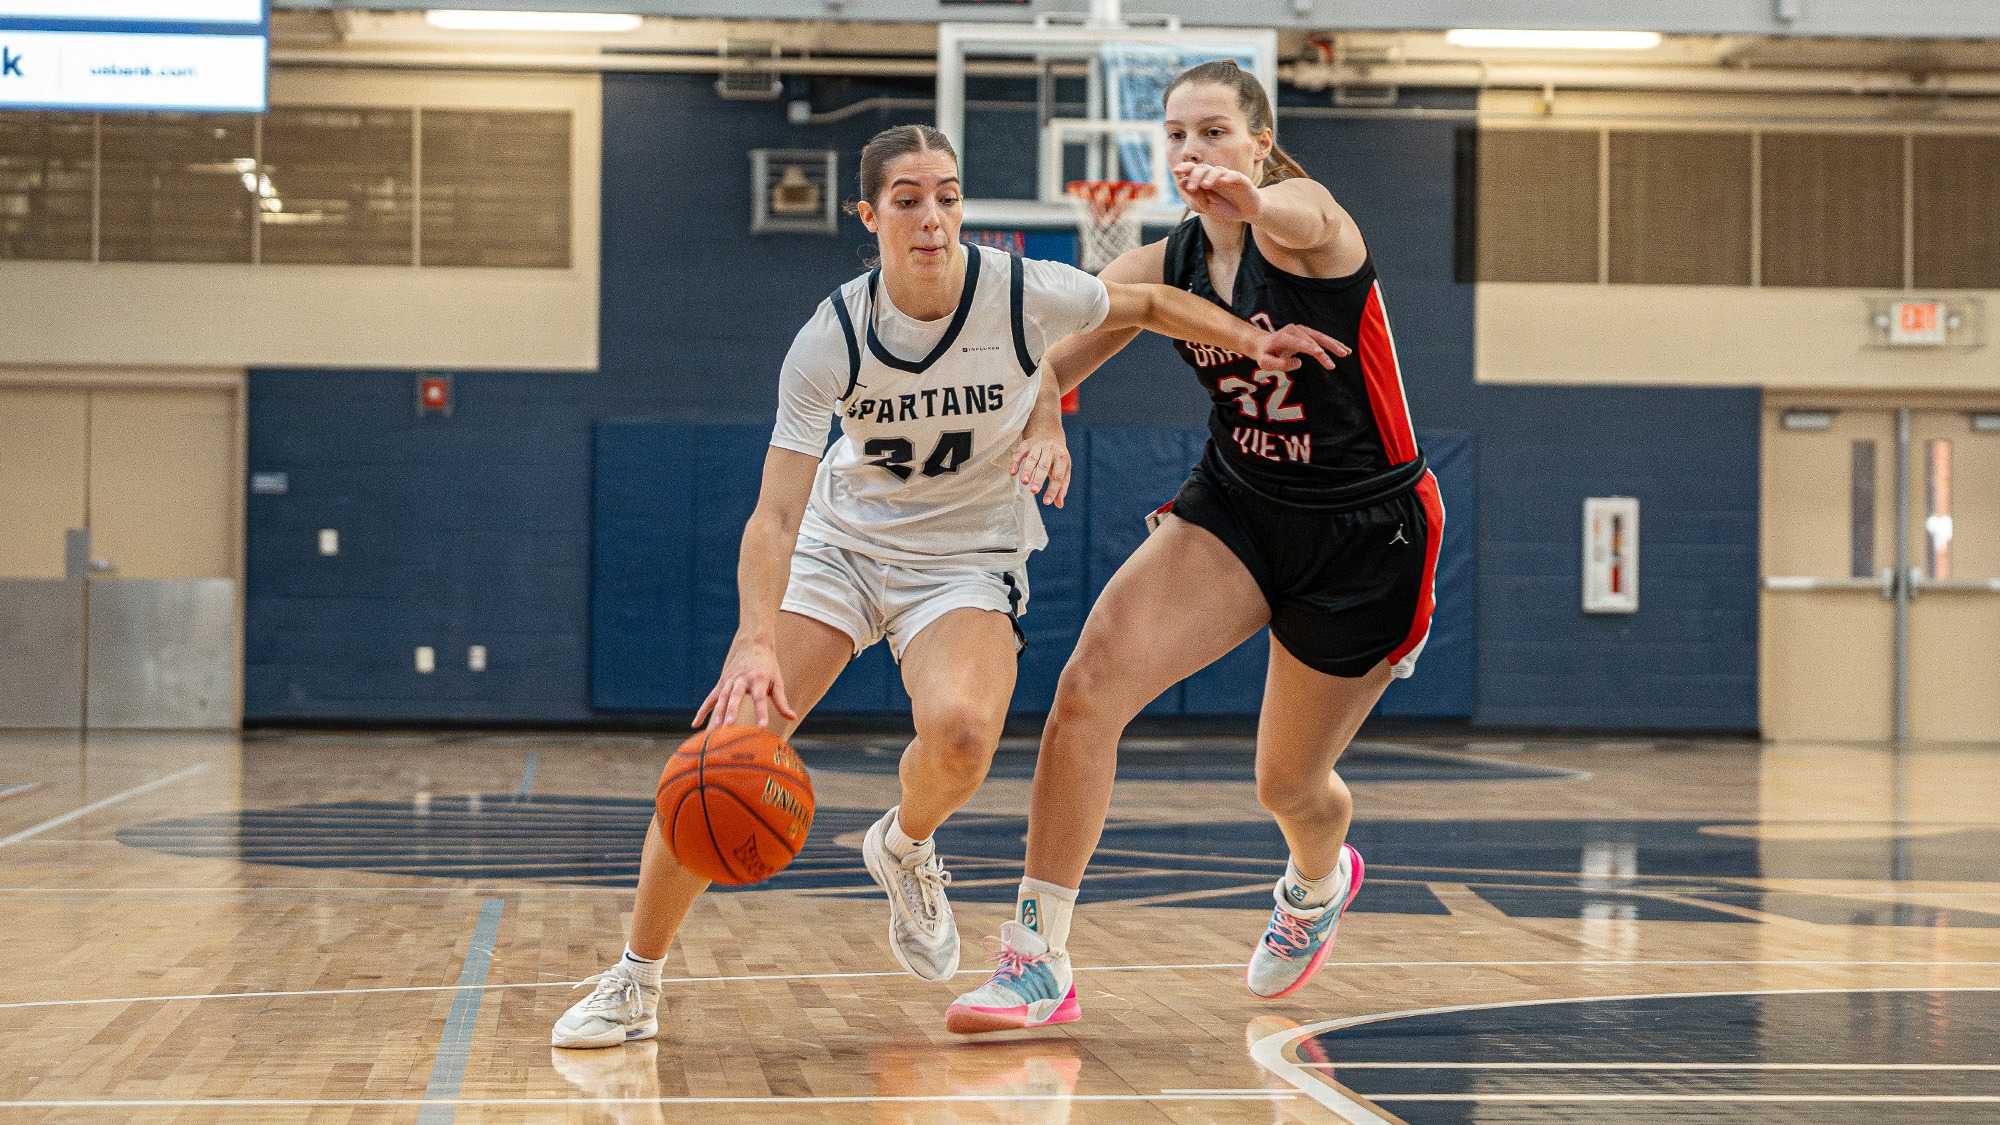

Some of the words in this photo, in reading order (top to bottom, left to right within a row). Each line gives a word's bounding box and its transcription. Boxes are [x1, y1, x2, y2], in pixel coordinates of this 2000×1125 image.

[847, 383, 1005, 424] SPARTANS
[1217, 367, 1306, 422] 32
[863, 428, 975, 484] 24
[1232, 426, 1312, 464] VIEW
